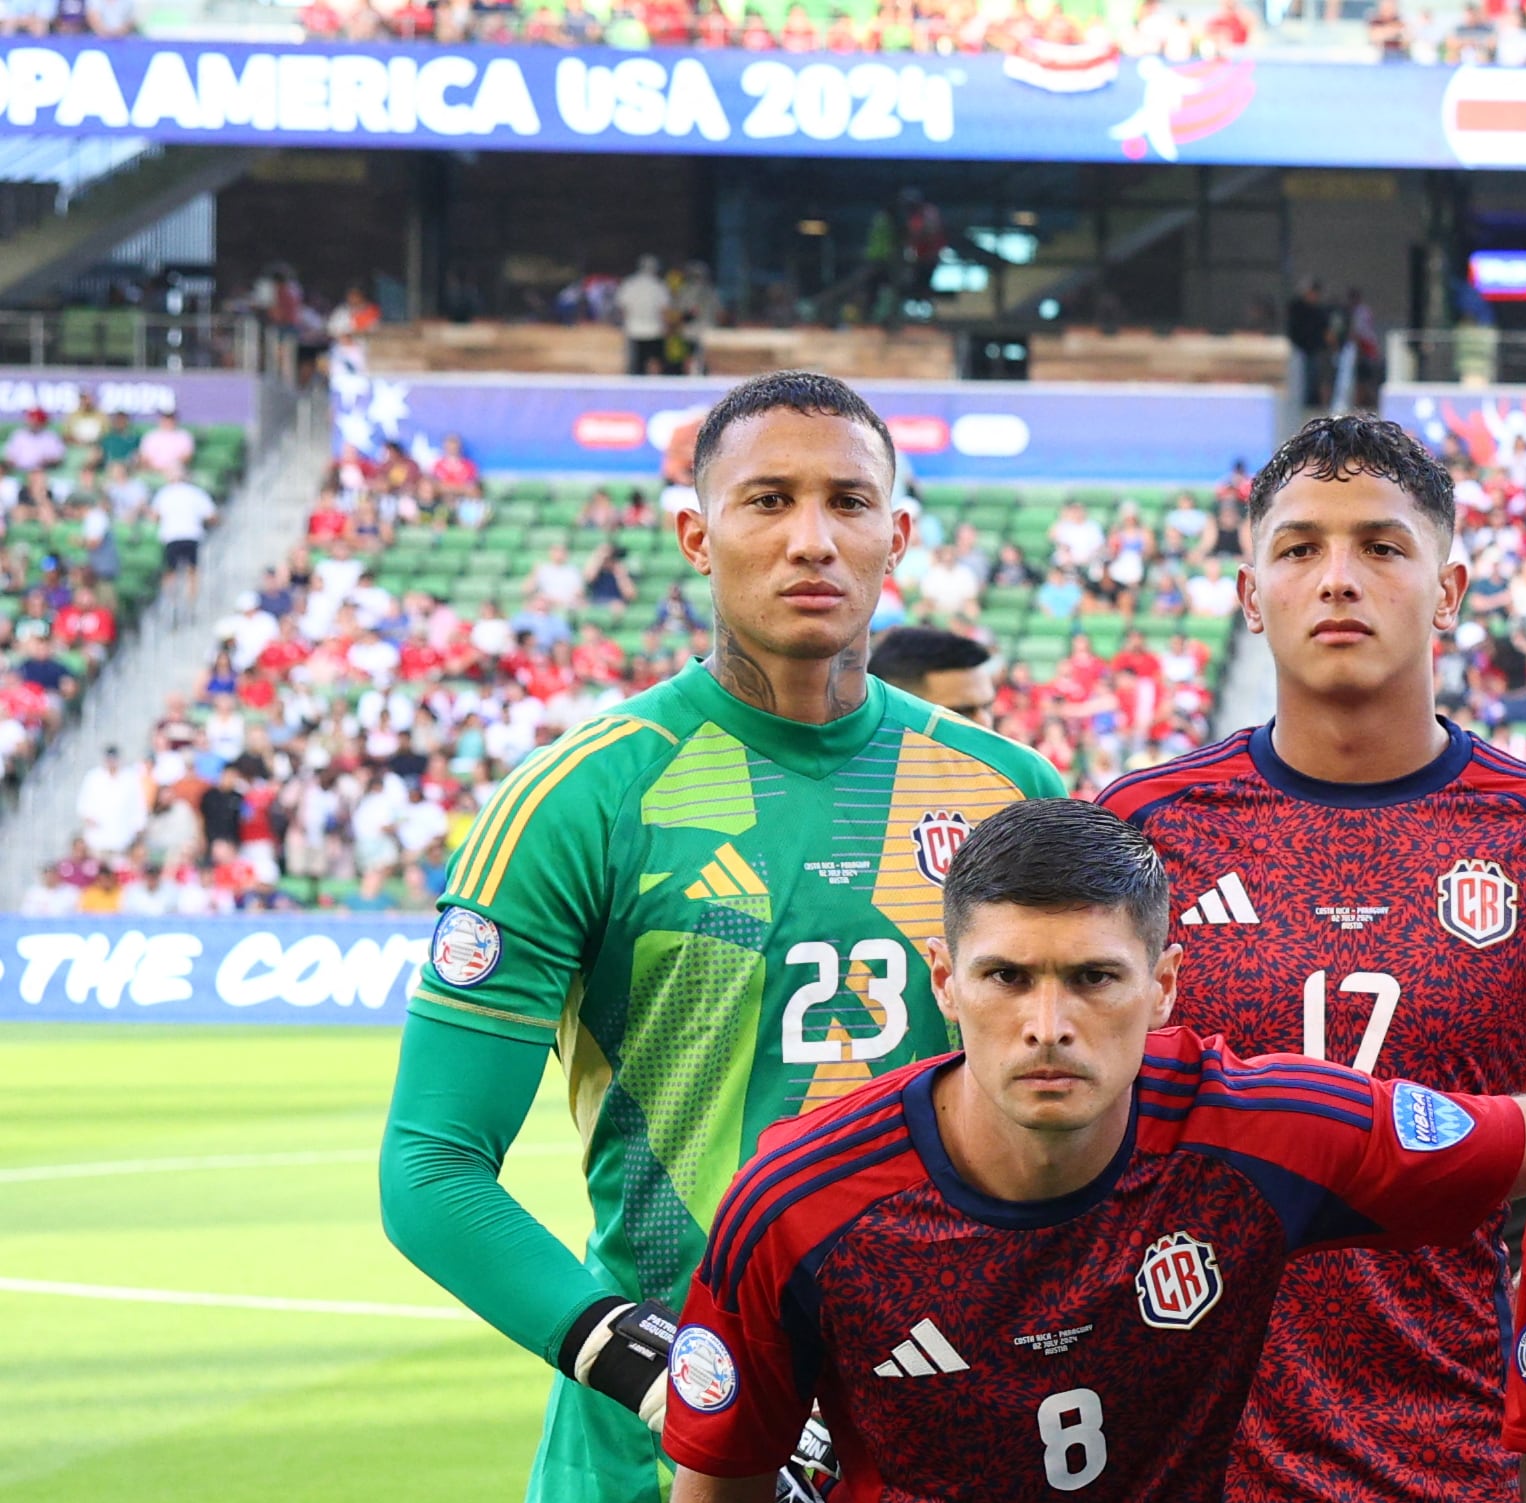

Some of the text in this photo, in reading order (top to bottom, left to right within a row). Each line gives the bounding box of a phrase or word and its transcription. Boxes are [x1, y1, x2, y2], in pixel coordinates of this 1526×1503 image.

[0, 48, 954, 142] PA AMERICA USA 2024
[1457, 877, 1499, 932] CR
[17, 930, 203, 1009] THE
[782, 938, 908, 1063] 23
[1303, 970, 1401, 1075] 17
[1411, 1092, 1431, 1142] VIBRA
[1151, 1250, 1202, 1312] CR
[1014, 1336, 1035, 1345] COSTA
[1037, 1388, 1107, 1491] 8
